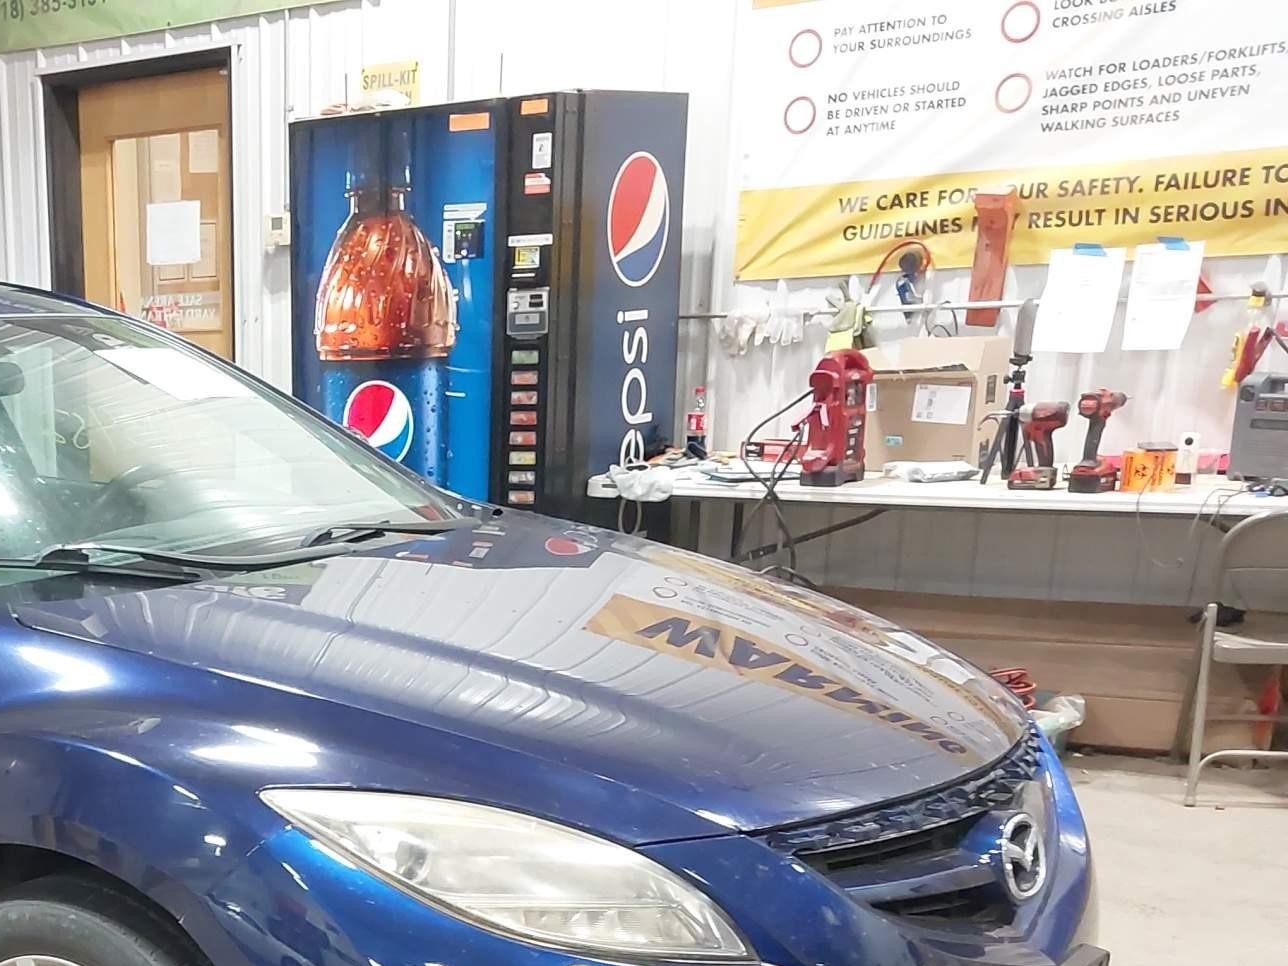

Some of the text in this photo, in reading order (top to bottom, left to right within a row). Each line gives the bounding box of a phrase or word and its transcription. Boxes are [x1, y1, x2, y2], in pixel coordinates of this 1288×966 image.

[834, 14, 948, 38] PAY ATTENTION TO
[1052, 1, 1177, 28] CROSSING AISLES
[833, 29, 972, 54] YOUR SURROUNDINGS
[363, 69, 417, 90] SPILL-KIT
[1043, 64, 1261, 98] JAGGED EDGES, LOOSE PARTS,
[1045, 66, 1093, 80] WATCH
[1098, 62, 1127, 75] FOR
[827, 80, 961, 104] NO VEHICLES SHOULD
[1041, 84, 1251, 116] SHARP POINTS AND UNEVEN
[827, 97, 967, 120] BE DRIVEN OR STARTED
[826, 120, 897, 136] AT ANYTIME
[1040, 110, 1181, 132] WALKING SURFACES
[838, 196, 869, 213] WE
[876, 191, 930, 210] CARE
[1057, 175, 1144, 198] SAFETY.
[1154, 167, 1252, 192] FAILURE
[843, 216, 962, 241] GUIDELINES
[1028, 208, 1106, 229] RESULT
[1114, 207, 1140, 225] IN
[1149, 199, 1255, 224] SERIOUS
[617, 310, 653, 468] epsi
